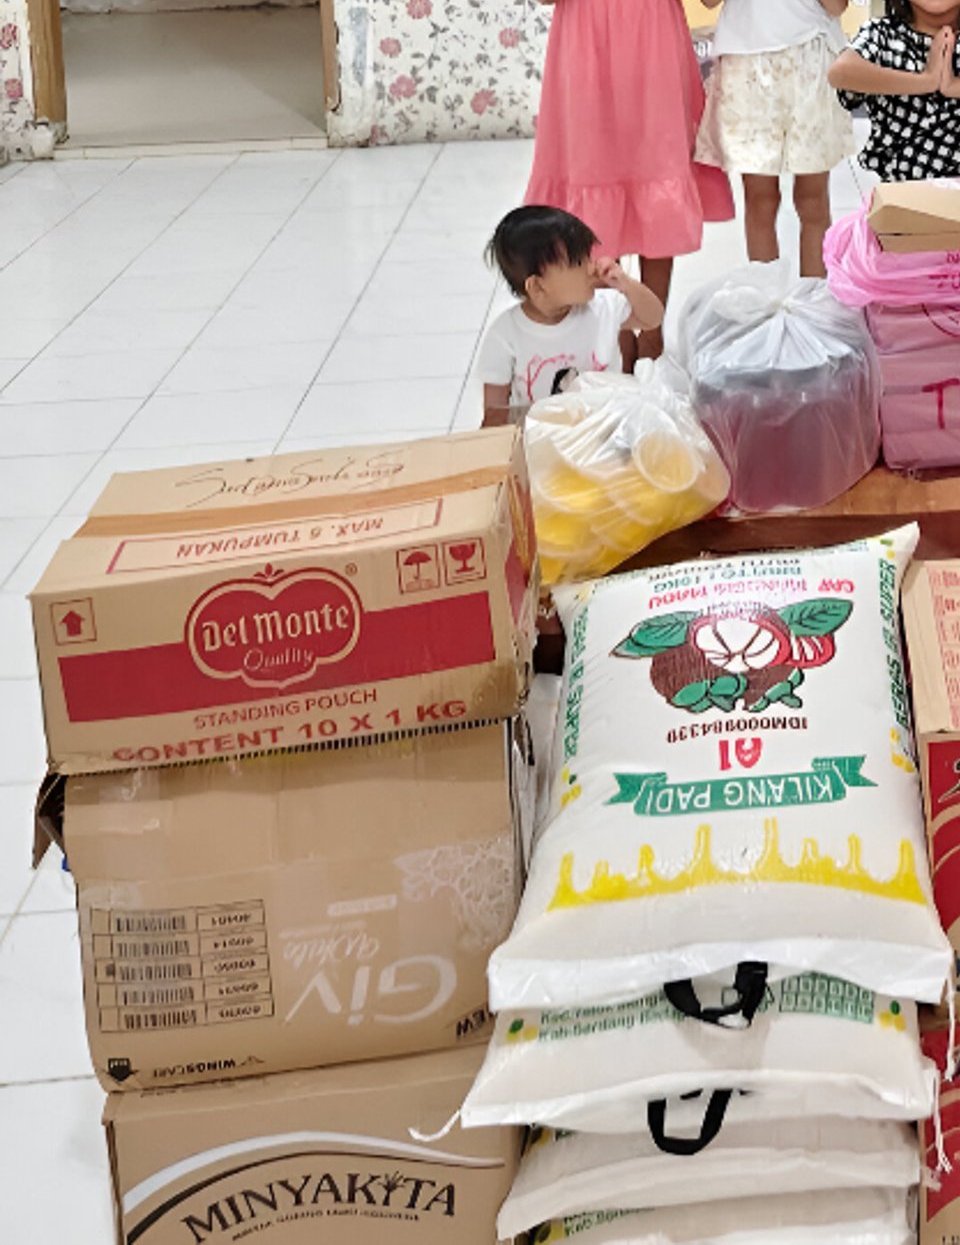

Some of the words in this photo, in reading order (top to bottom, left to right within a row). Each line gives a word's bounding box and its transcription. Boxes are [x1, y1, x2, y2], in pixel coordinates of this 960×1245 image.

[175, 529, 301, 558] TUMPUKAN
[331, 516, 385, 538] MAX.
[877, 557, 898, 628] SUPER
[202, 615, 249, 653] Del
[256, 603, 349, 644] Monte
[243, 646, 314, 675] Quality
[193, 699, 302, 732] STANDING
[303, 687, 379, 713] POUCH
[112, 723, 285, 762] CONTENT
[298, 718, 338, 740] 10
[348, 713, 374, 734] X
[384, 709, 403, 729] 1
[415, 698, 468, 722] KG
[718, 737, 763, 772] A1
[645, 783, 712, 815] PADI
[723, 773, 833, 808] KILANG
[281, 954, 457, 1026] Giv
[180, 1170, 457, 1245] MINYAKITA
